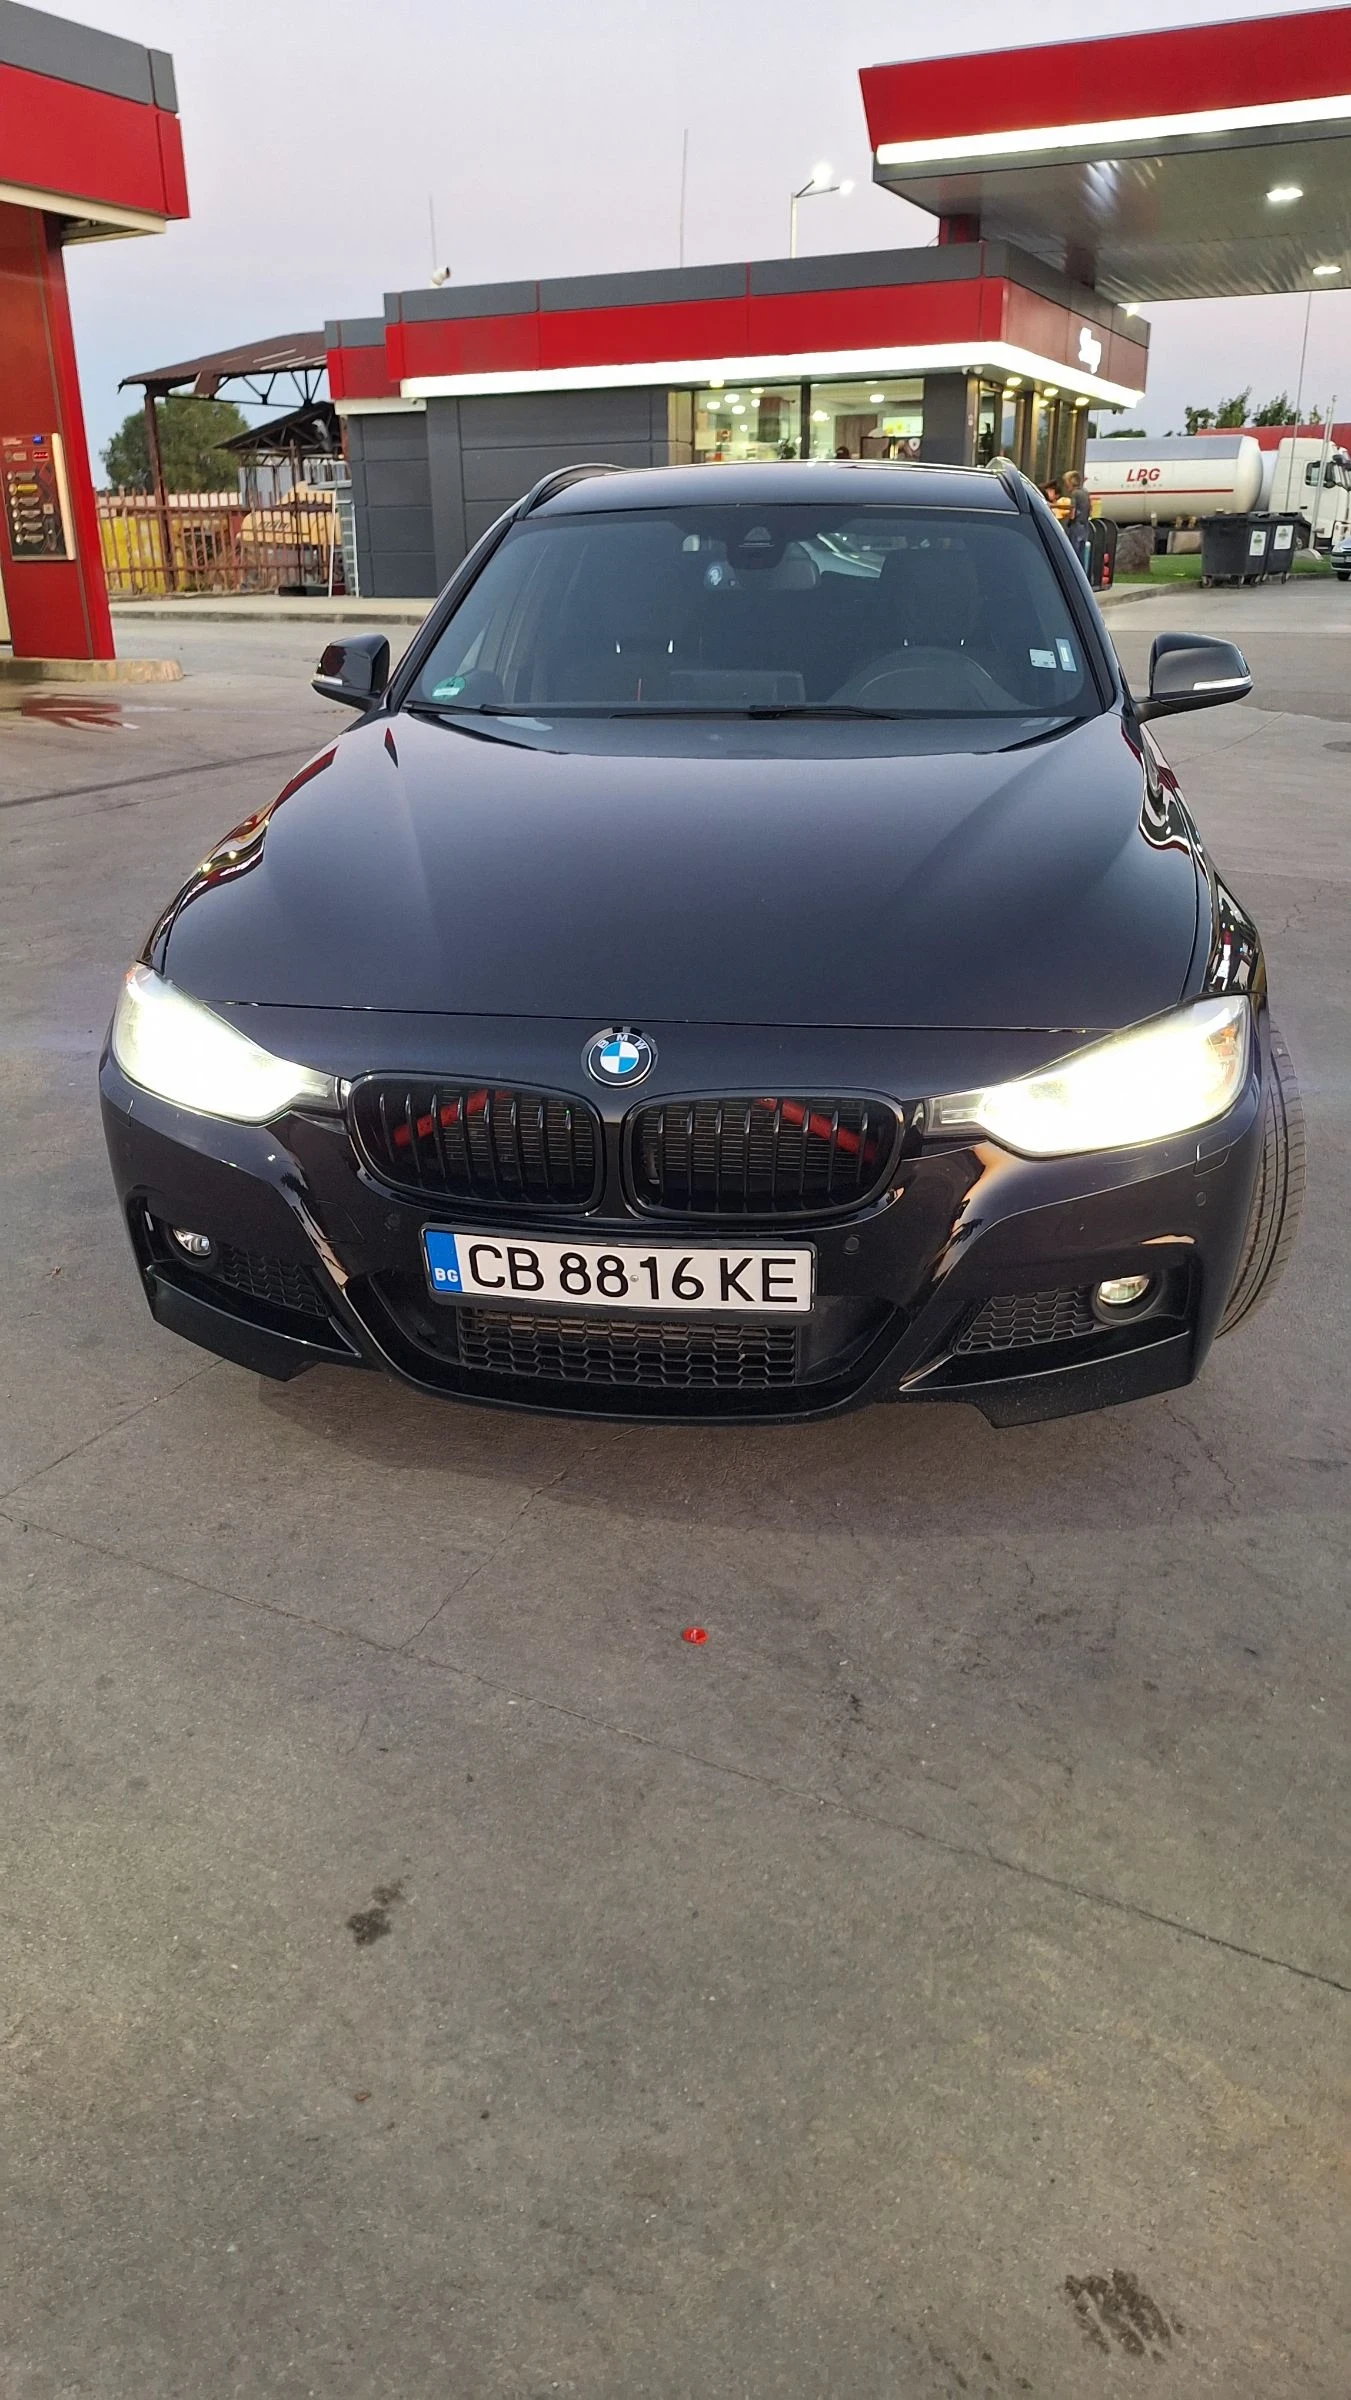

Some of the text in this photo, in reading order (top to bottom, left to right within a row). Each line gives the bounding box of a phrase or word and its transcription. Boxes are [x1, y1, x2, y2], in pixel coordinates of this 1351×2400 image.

[1126, 468, 1160, 482] LPG
[597, 1034, 647, 1050] BMW
[434, 1268, 459, 1283] BG
[469, 1244, 798, 1303] CB 8816 KE
